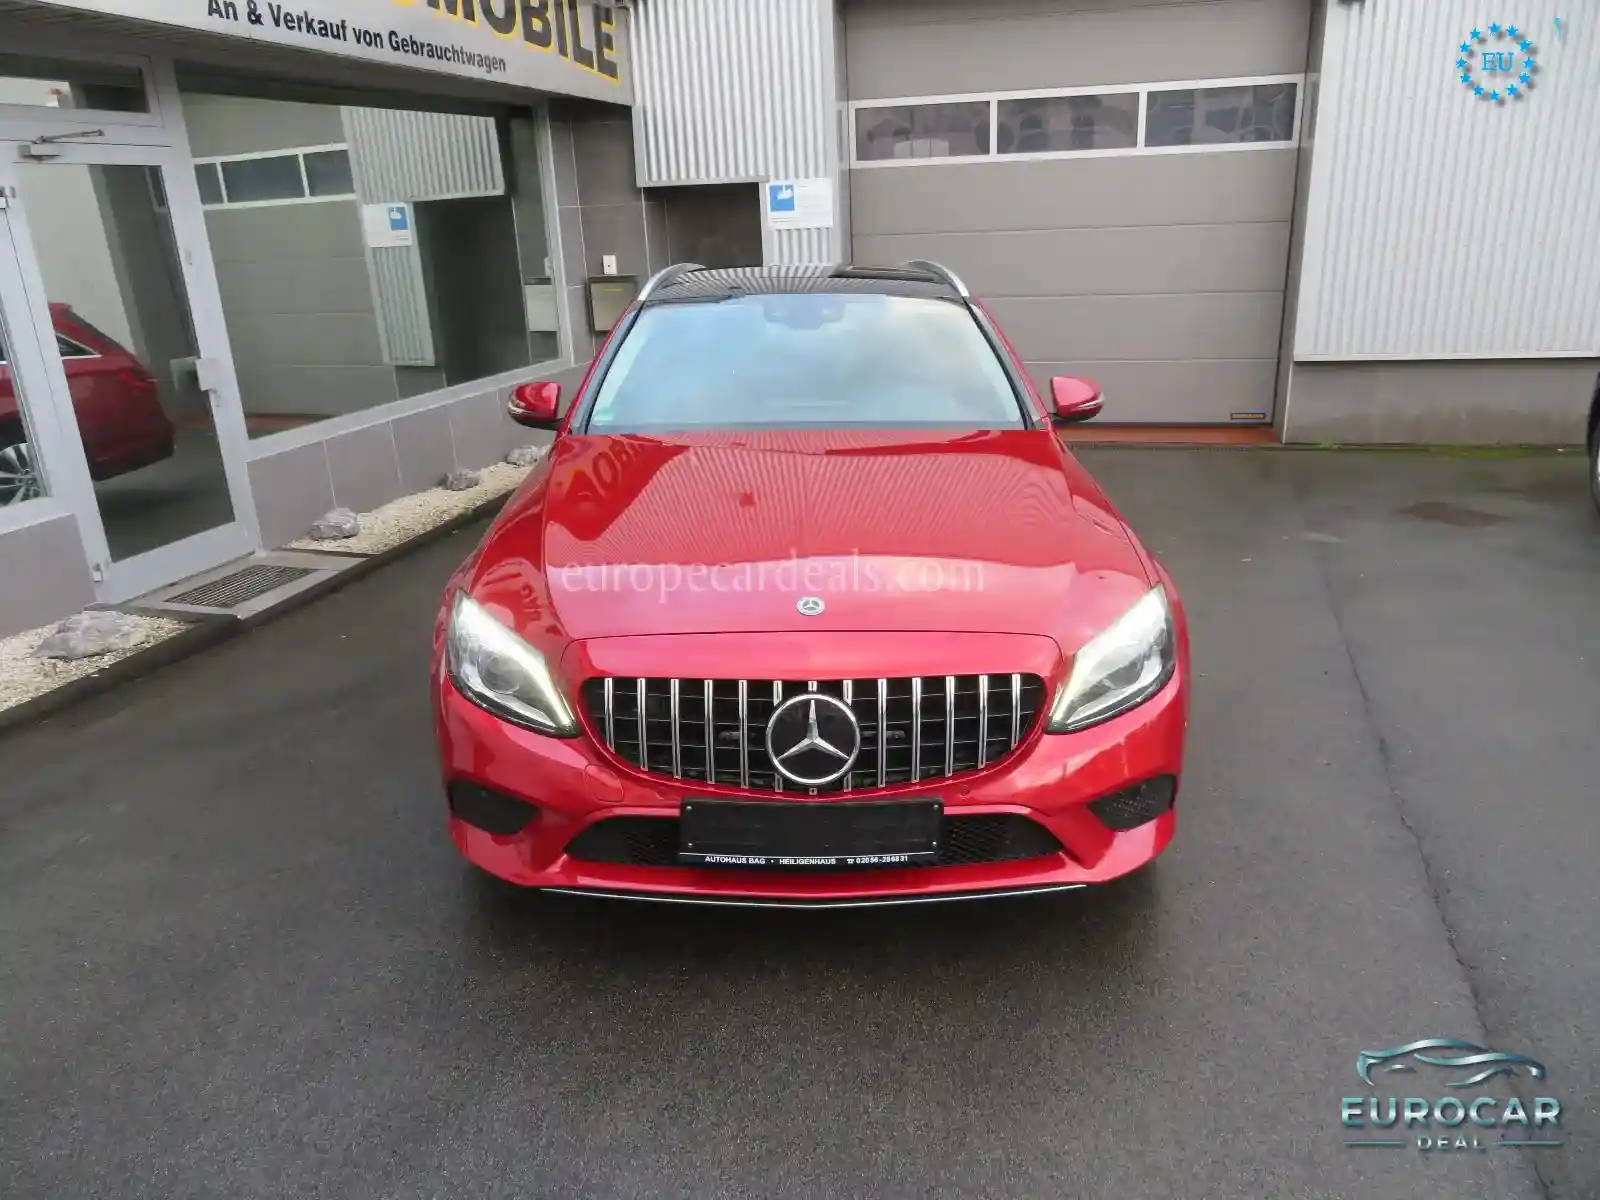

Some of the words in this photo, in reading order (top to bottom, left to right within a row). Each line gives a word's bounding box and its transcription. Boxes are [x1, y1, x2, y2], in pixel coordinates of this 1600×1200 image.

[207, 0, 239, 21] An
[246, 0, 265, 26] &
[267, 2, 348, 42] Verkauf
[352, 27, 384, 49] von
[388, 29, 507, 74] Gebrauchtwagen
[704, 855, 747, 865] AUTOHAUS
[748, 857, 766, 865] BAG
[779, 858, 837, 866] HEILIGENHAUS
